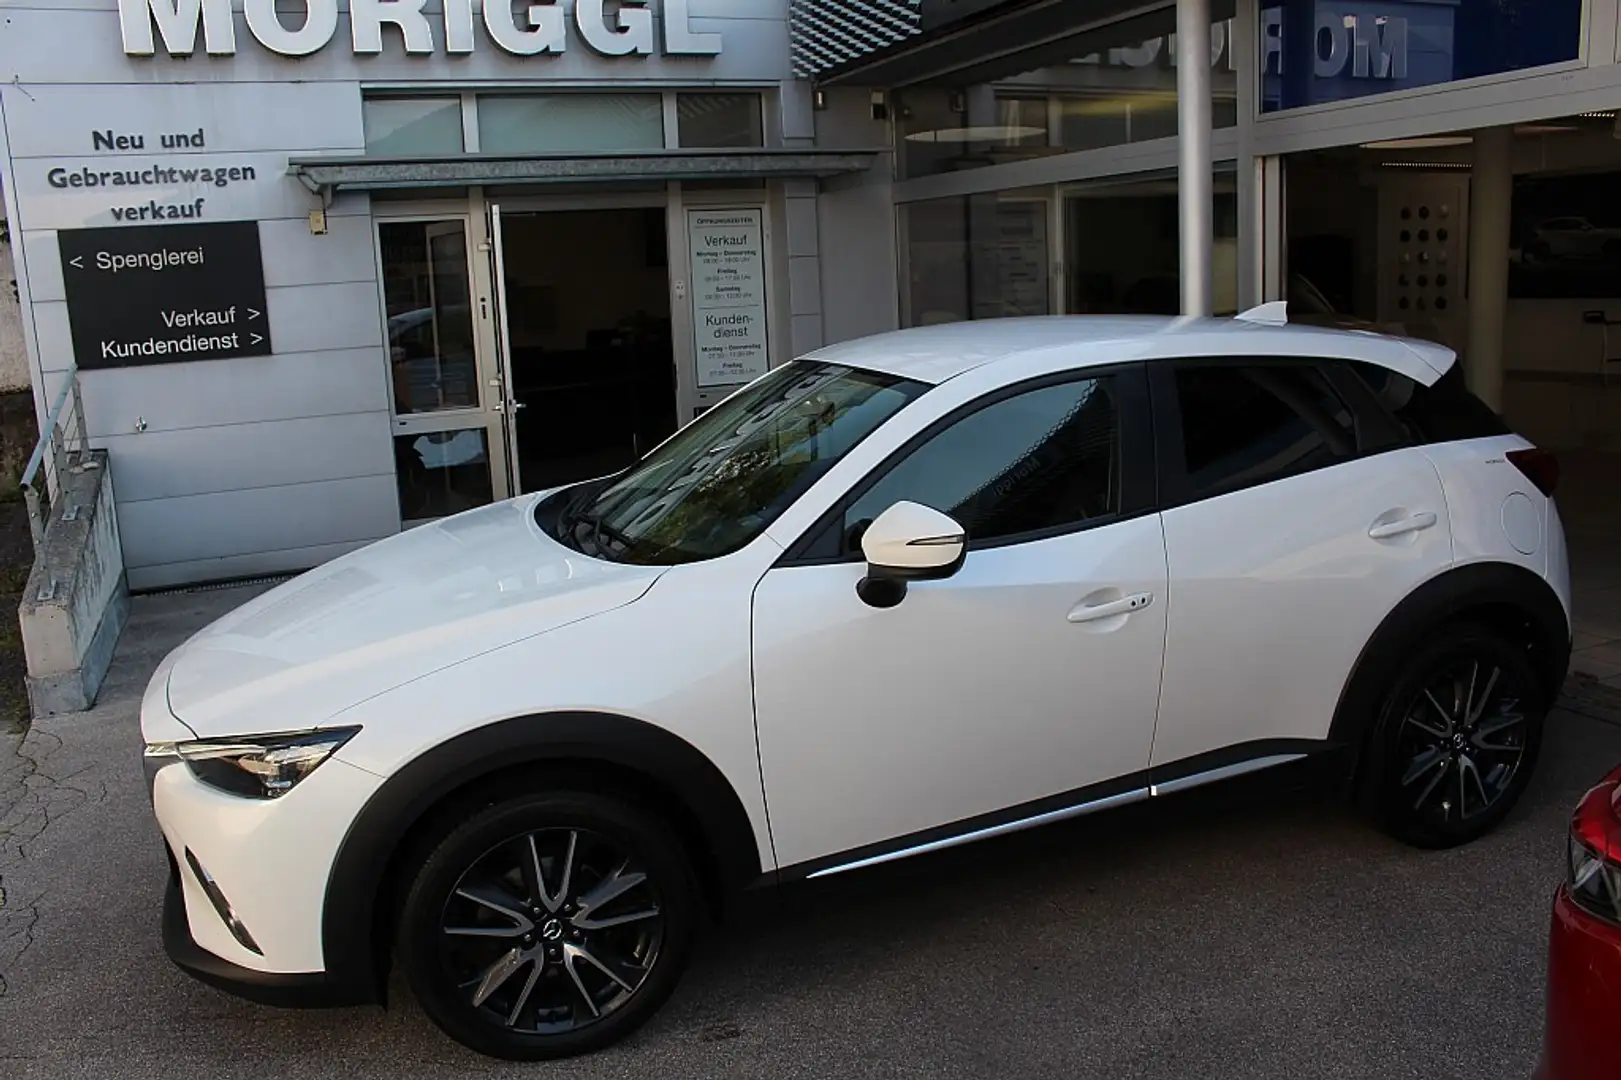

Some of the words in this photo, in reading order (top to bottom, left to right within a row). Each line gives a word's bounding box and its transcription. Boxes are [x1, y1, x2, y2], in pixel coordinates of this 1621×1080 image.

[92, 130, 144, 151] Neu
[161, 128, 205, 149] und
[47, 164, 256, 190] Gebrauchtwagen
[111, 197, 205, 221] verkauf
[704, 234, 747, 247] Verkauf
[96, 247, 204, 272] Spenglerei
[161, 305, 236, 329] Verkauf
[705, 313, 754, 327] Kunden-
[713, 326, 749, 339] dienst
[101, 331, 239, 359] Kundendienst
